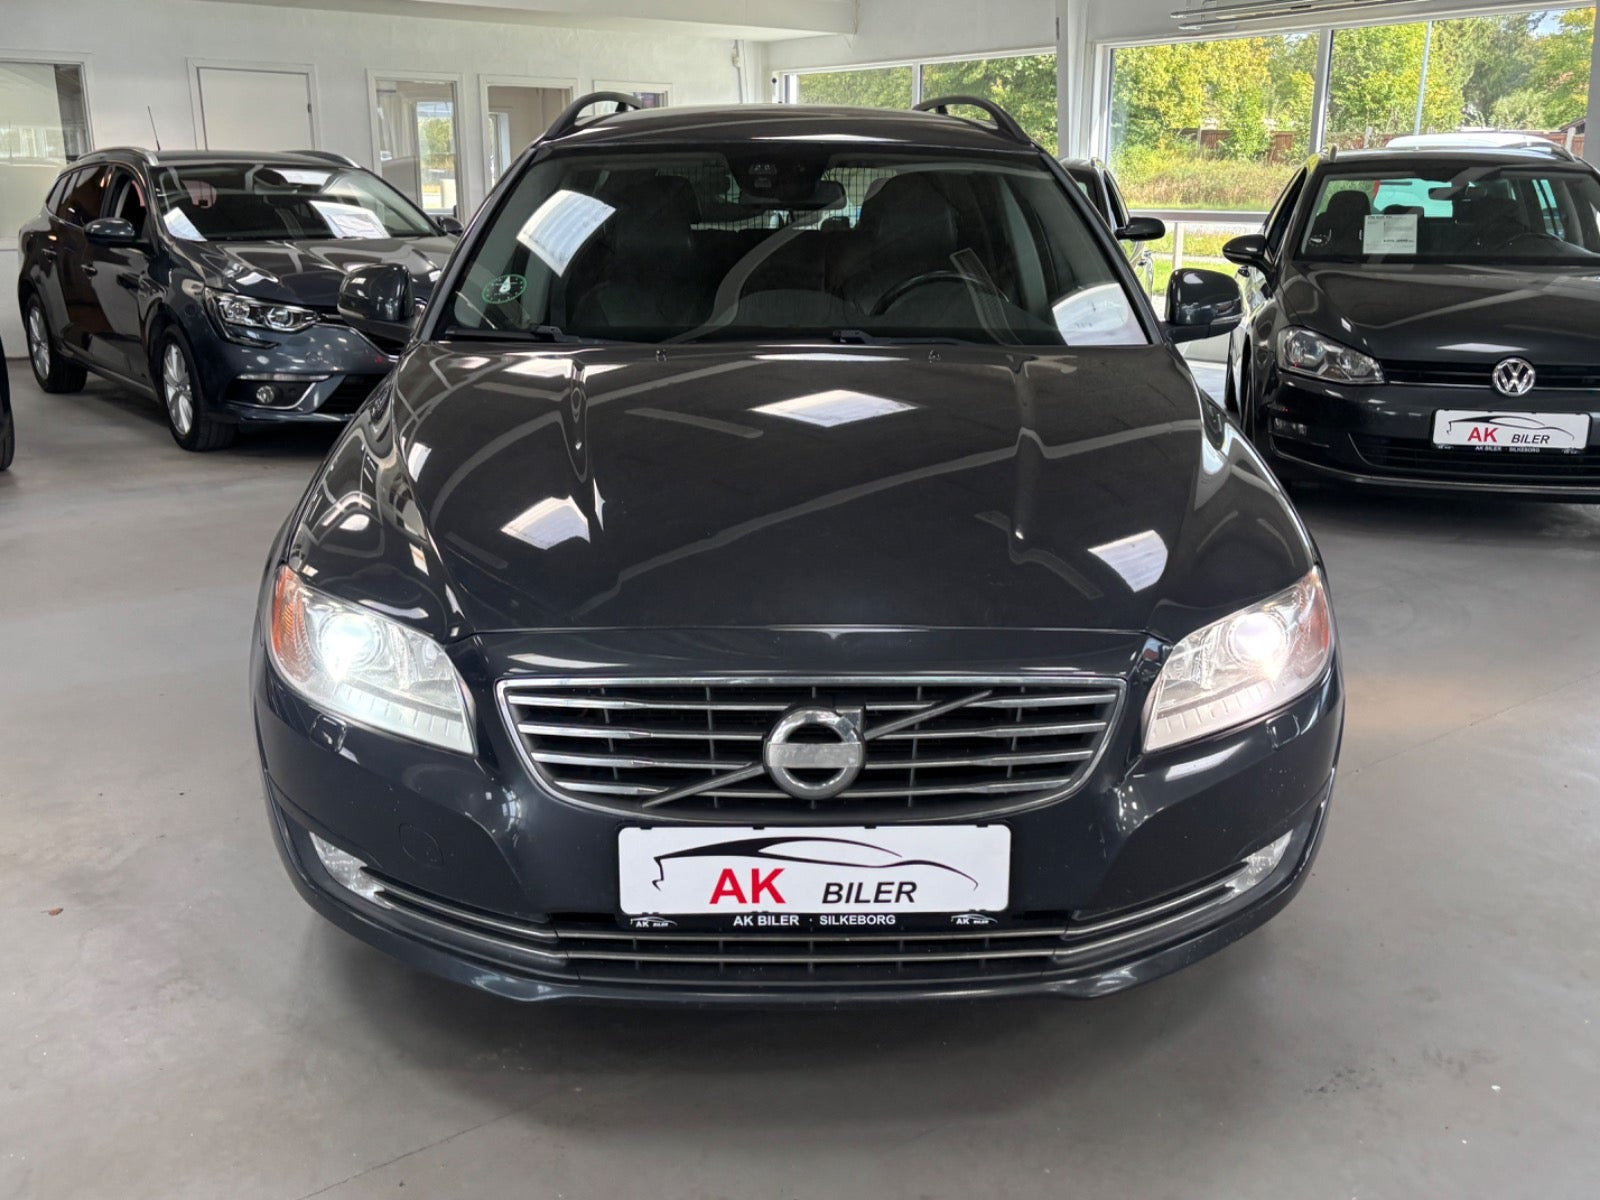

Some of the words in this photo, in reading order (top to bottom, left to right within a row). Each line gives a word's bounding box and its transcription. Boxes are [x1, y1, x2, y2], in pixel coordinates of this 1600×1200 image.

[1467, 427, 1498, 442] AK
[1511, 434, 1550, 444] BILER
[709, 868, 786, 904] AK
[822, 882, 917, 904] BILER
[733, 915, 754, 926] AK
[757, 915, 800, 926] BILER
[819, 914, 896, 925] SILKEBORG
